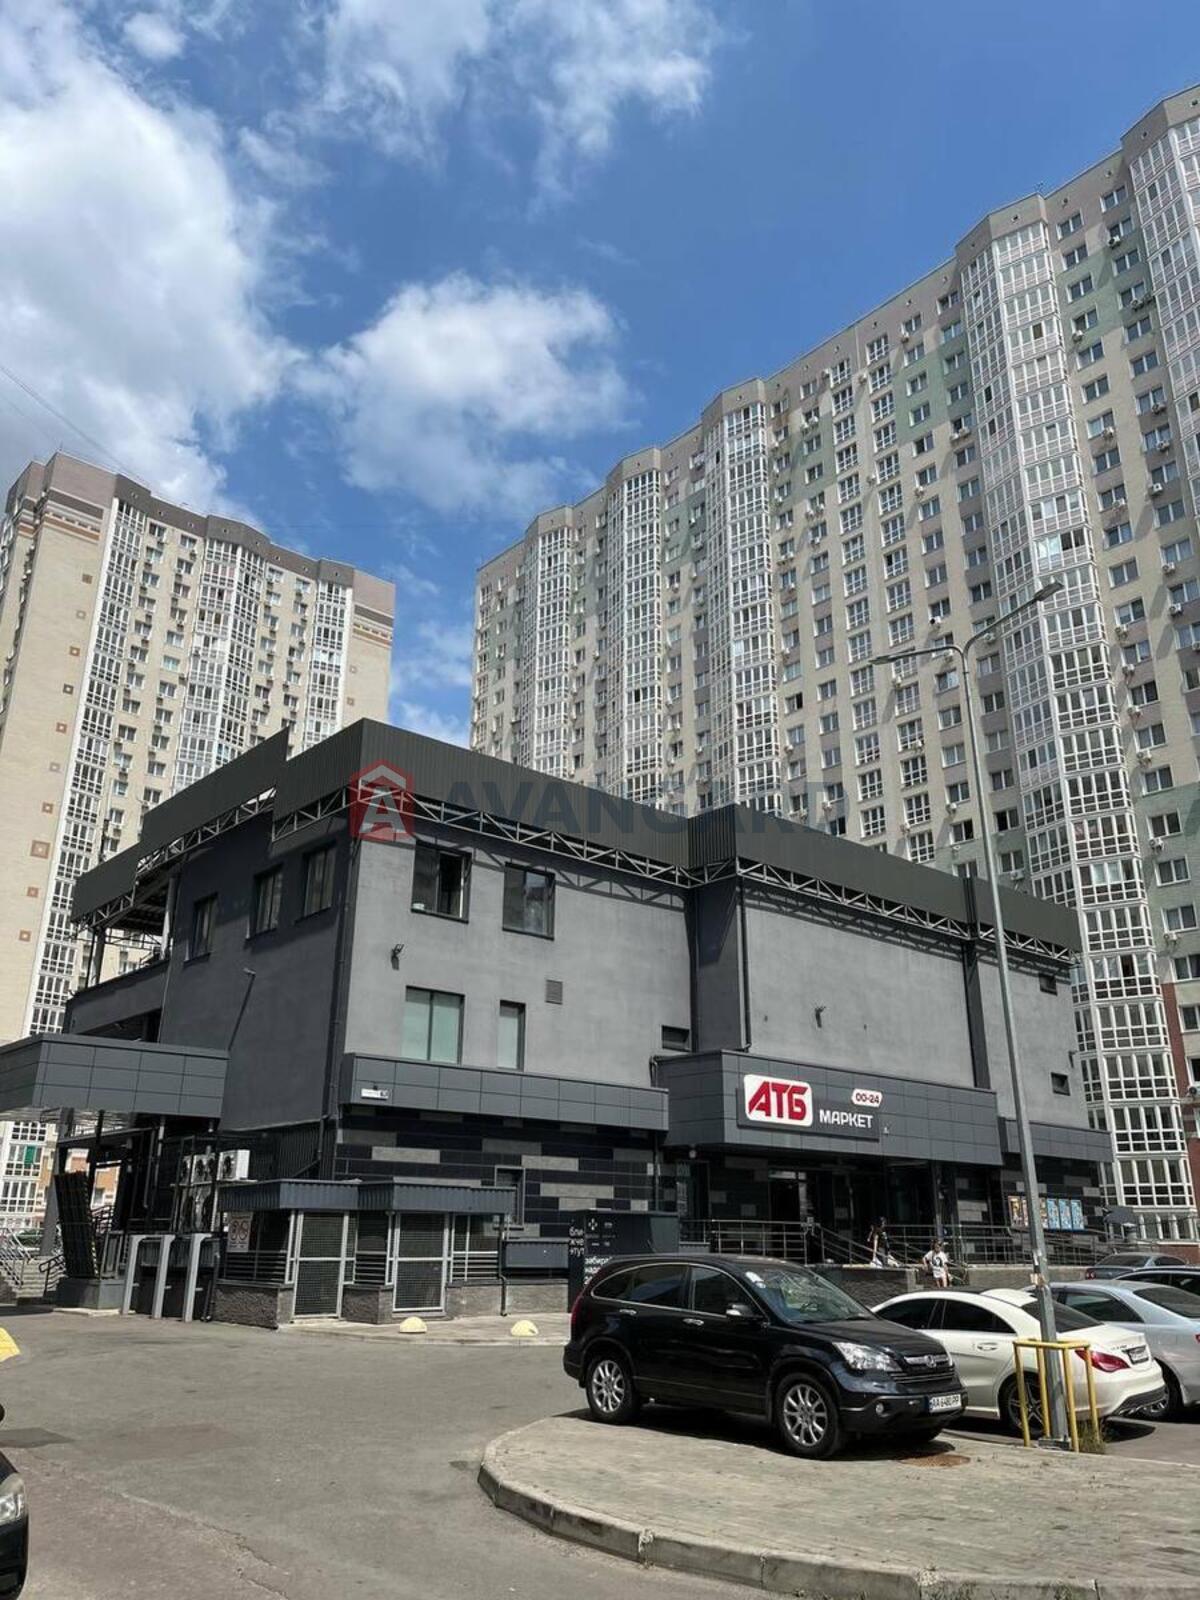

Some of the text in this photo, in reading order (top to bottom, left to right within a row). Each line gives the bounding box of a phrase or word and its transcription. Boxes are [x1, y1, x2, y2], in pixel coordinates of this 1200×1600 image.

[748, 1080, 809, 1121] АТБ
[855, 1092, 880, 1104] 00-24
[819, 1109, 874, 1129] МАРКЕТ
